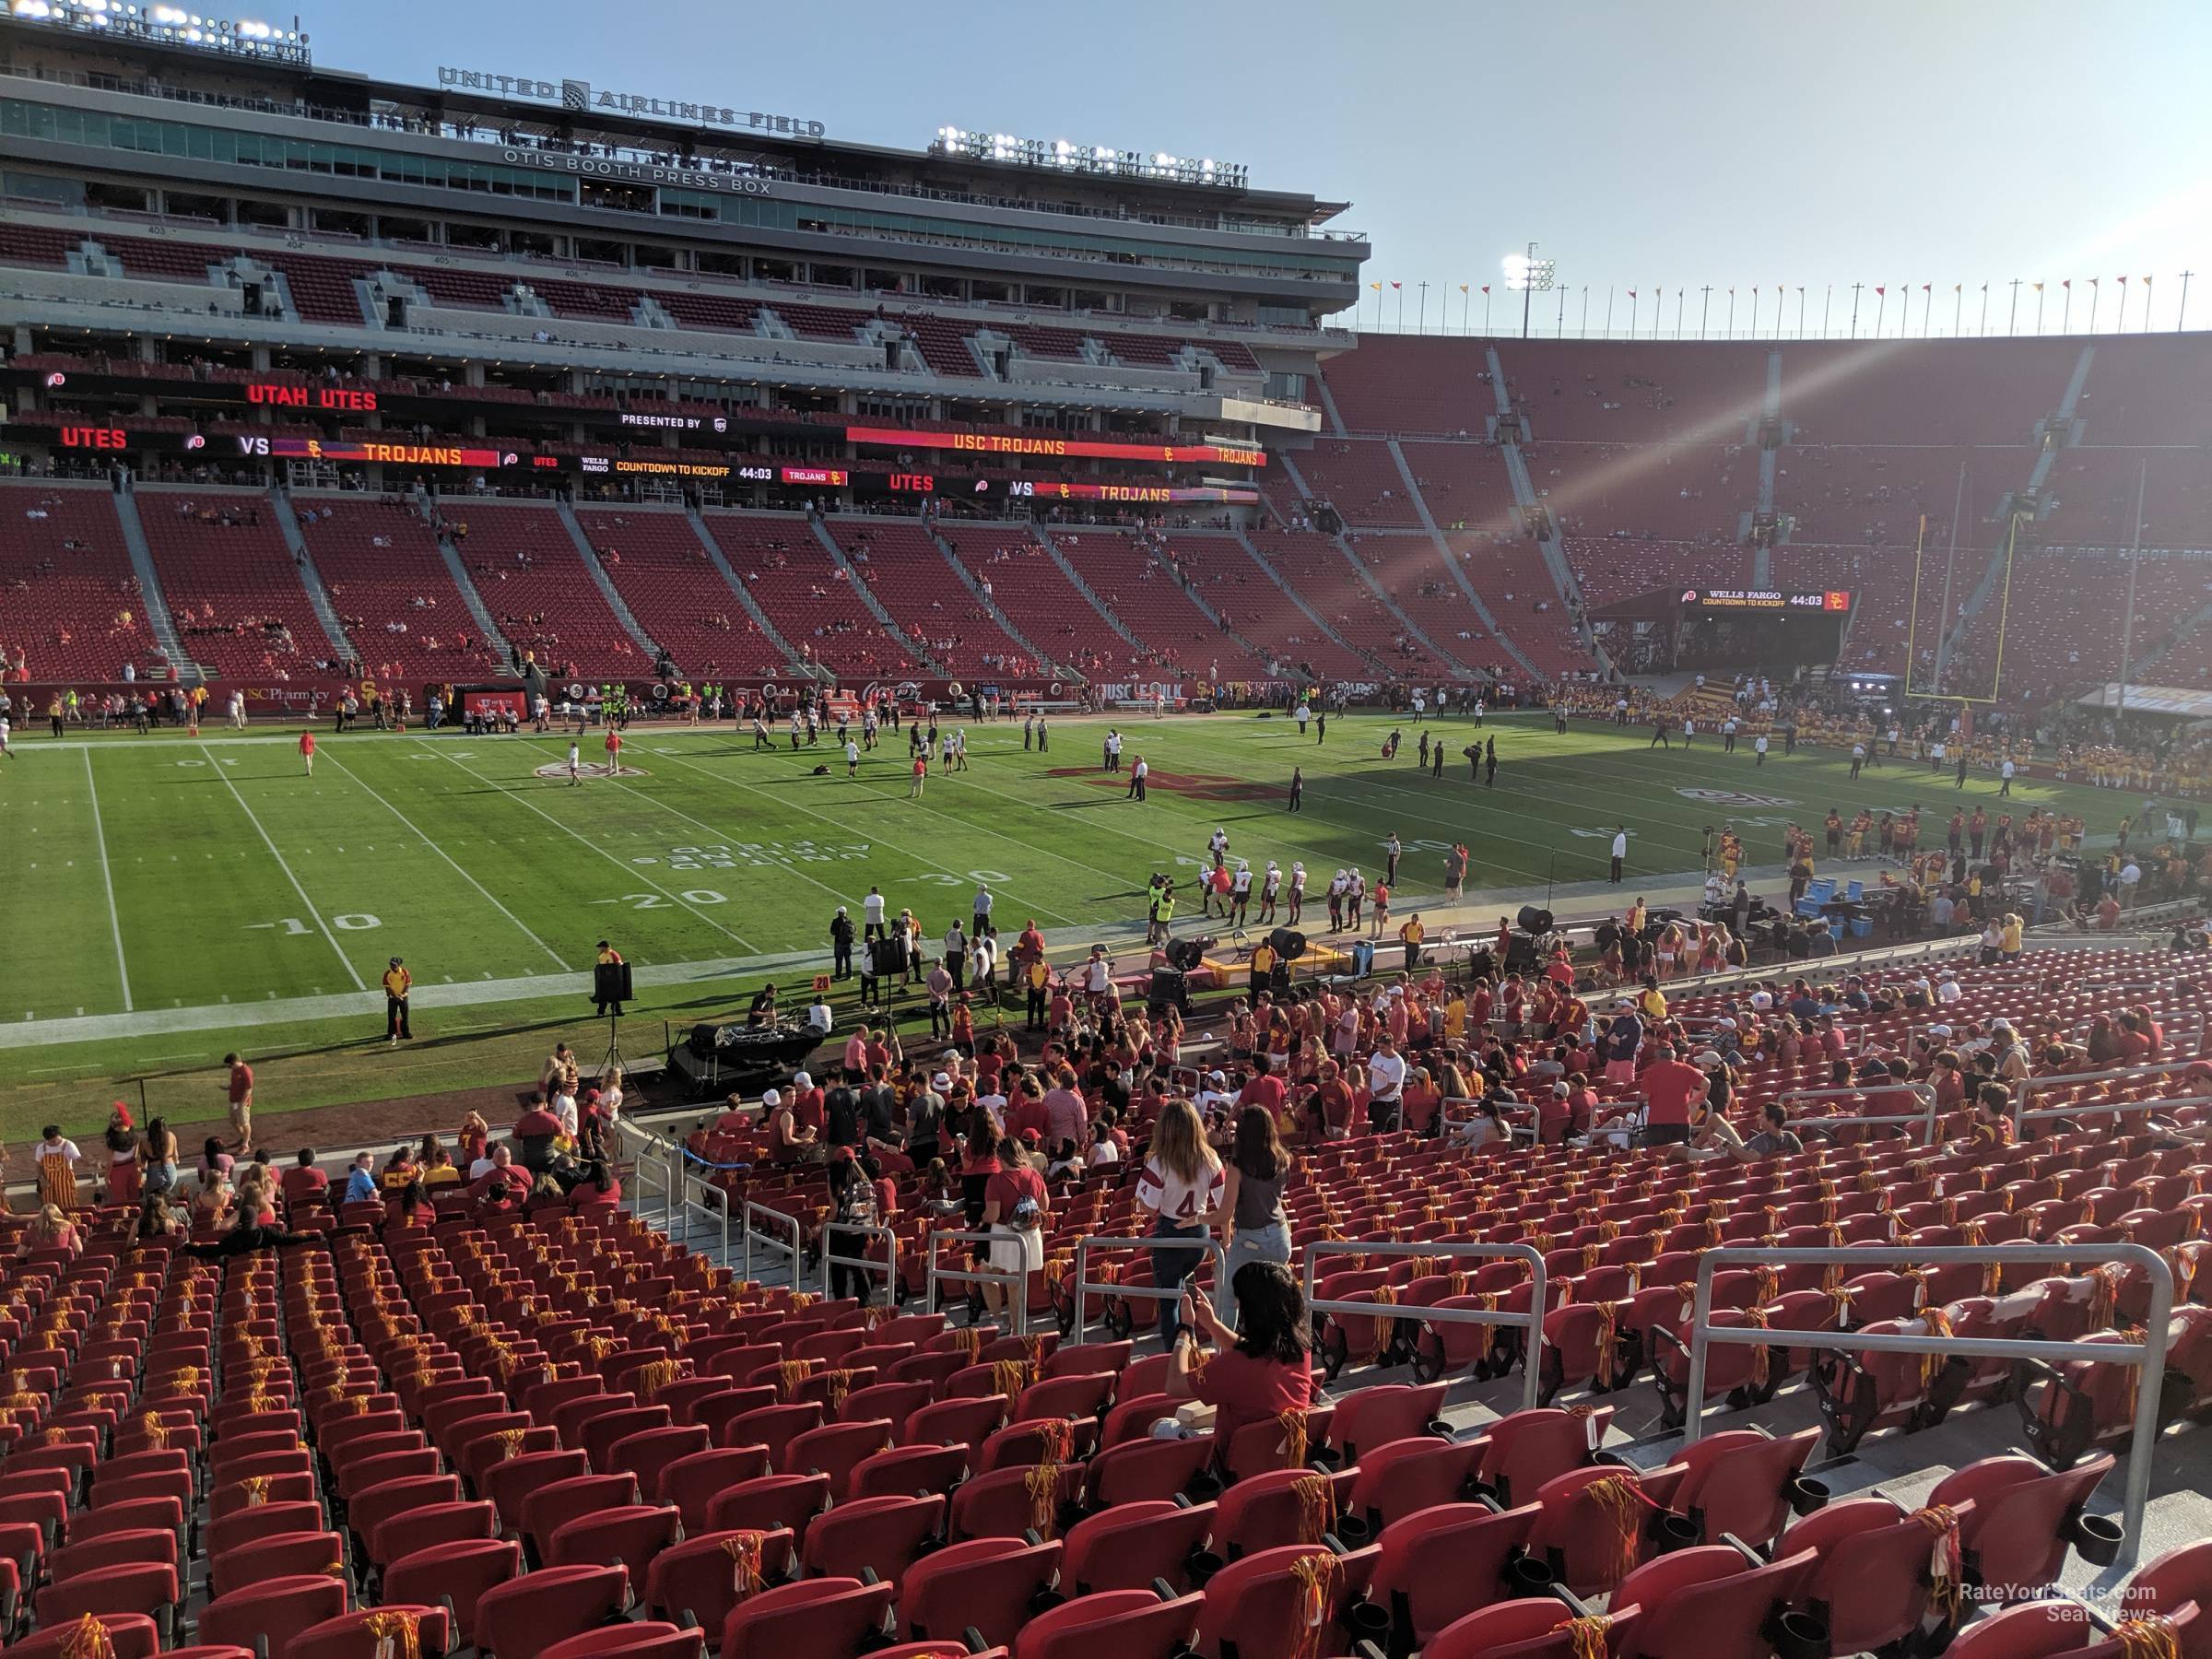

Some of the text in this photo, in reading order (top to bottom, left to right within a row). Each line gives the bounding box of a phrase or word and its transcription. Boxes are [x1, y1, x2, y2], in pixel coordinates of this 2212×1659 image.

[439, 66, 825, 136] UNITED AIRLINES FIELD
[504, 150, 771, 194] OTIS BOOTH PRESS BOX
[148, 227, 166, 236] 403
[249, 384, 376, 410] UTAH UTES
[622, 415, 700, 429] PRESENTED BY
[62, 427, 126, 449] UTES
[954, 434, 1065, 454] USC TROJANS
[240, 437, 269, 455] VS
[364, 443, 463, 465] TROJANS
[582, 457, 608, 465] WELLS
[1218, 448, 1257, 465] TROJANS
[534, 457, 559, 467] UTES
[582, 465, 608, 473] FARGO
[617, 462, 730, 477] COUNTDOWN TO KICKOFF
[739, 467, 772, 480] 44:03
[789, 471, 827, 482] TROJANS
[889, 474, 934, 491] UTES
[1012, 481, 1032, 496] VS
[1100, 486, 1171, 501] TROJANS
[1710, 591, 1782, 599] WELLS FARGO
[1791, 595, 1823, 606] 44:03
[1594, 623, 1606, 633] 34
[919, 870, 1013, 886] 30
[621, 889, 729, 909] 20
[279, 913, 383, 935] 10
[817, 977, 829, 989] 20
[1568, 1005, 1580, 1023] 7
[462, 1134, 472, 1149] 7
[1141, 1184, 1148, 1195] 4
[1175, 1191, 1198, 1218] 4
